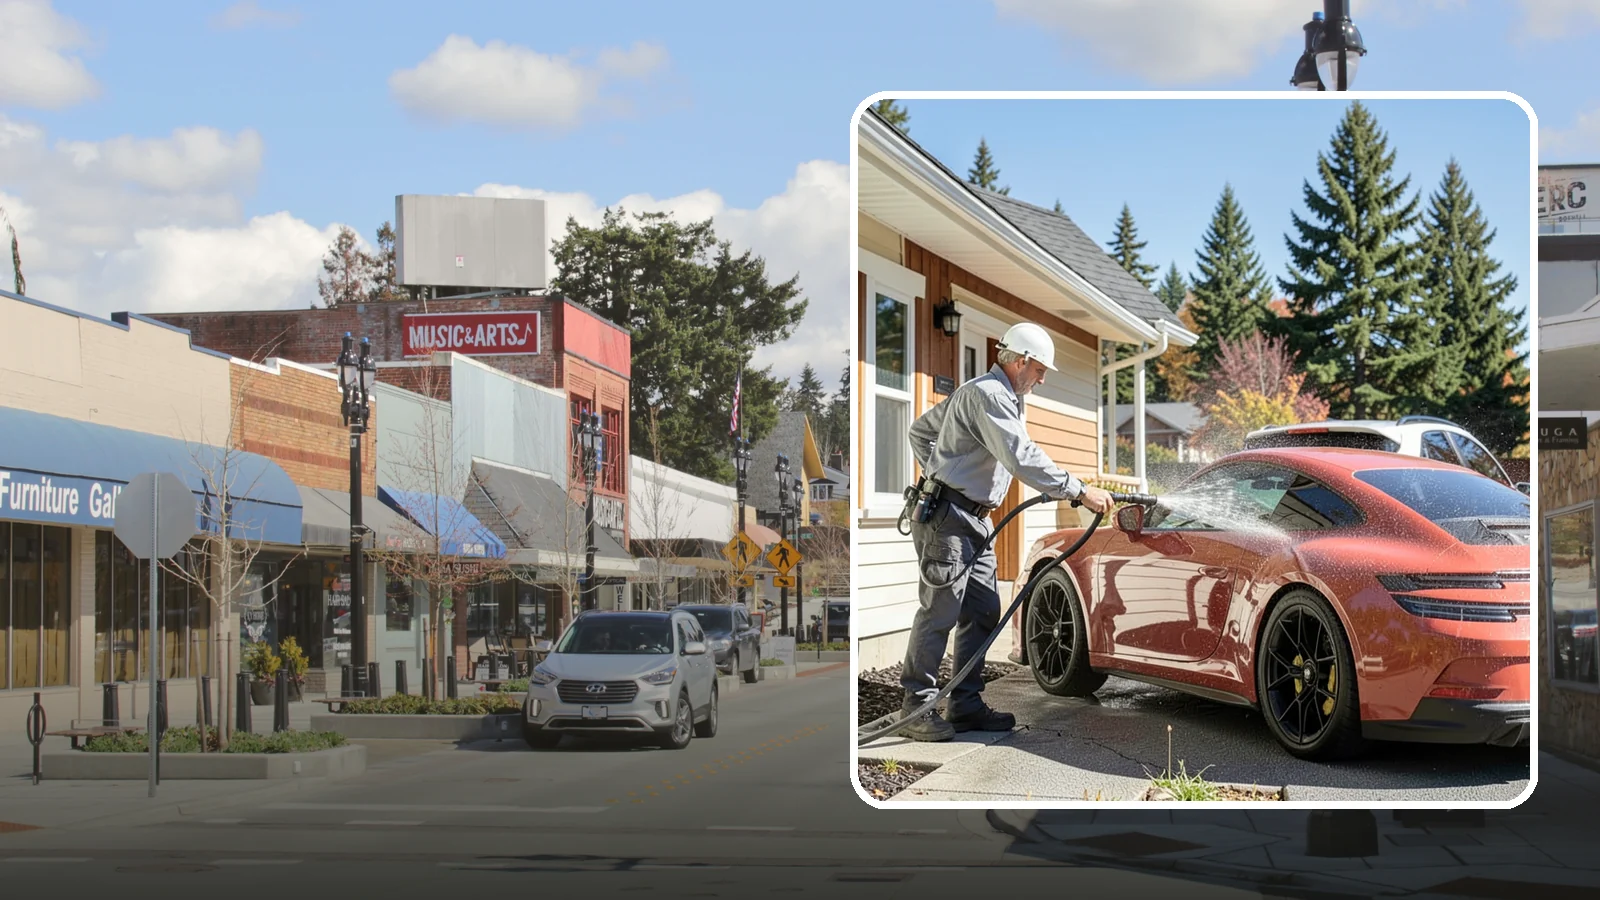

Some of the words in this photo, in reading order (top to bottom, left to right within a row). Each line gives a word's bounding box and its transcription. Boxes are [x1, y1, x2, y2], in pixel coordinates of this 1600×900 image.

[409, 322, 519, 349] MUSIC&ARTS
[0, 471, 80, 515] Furniture
[89, 481, 122, 519] Gal
